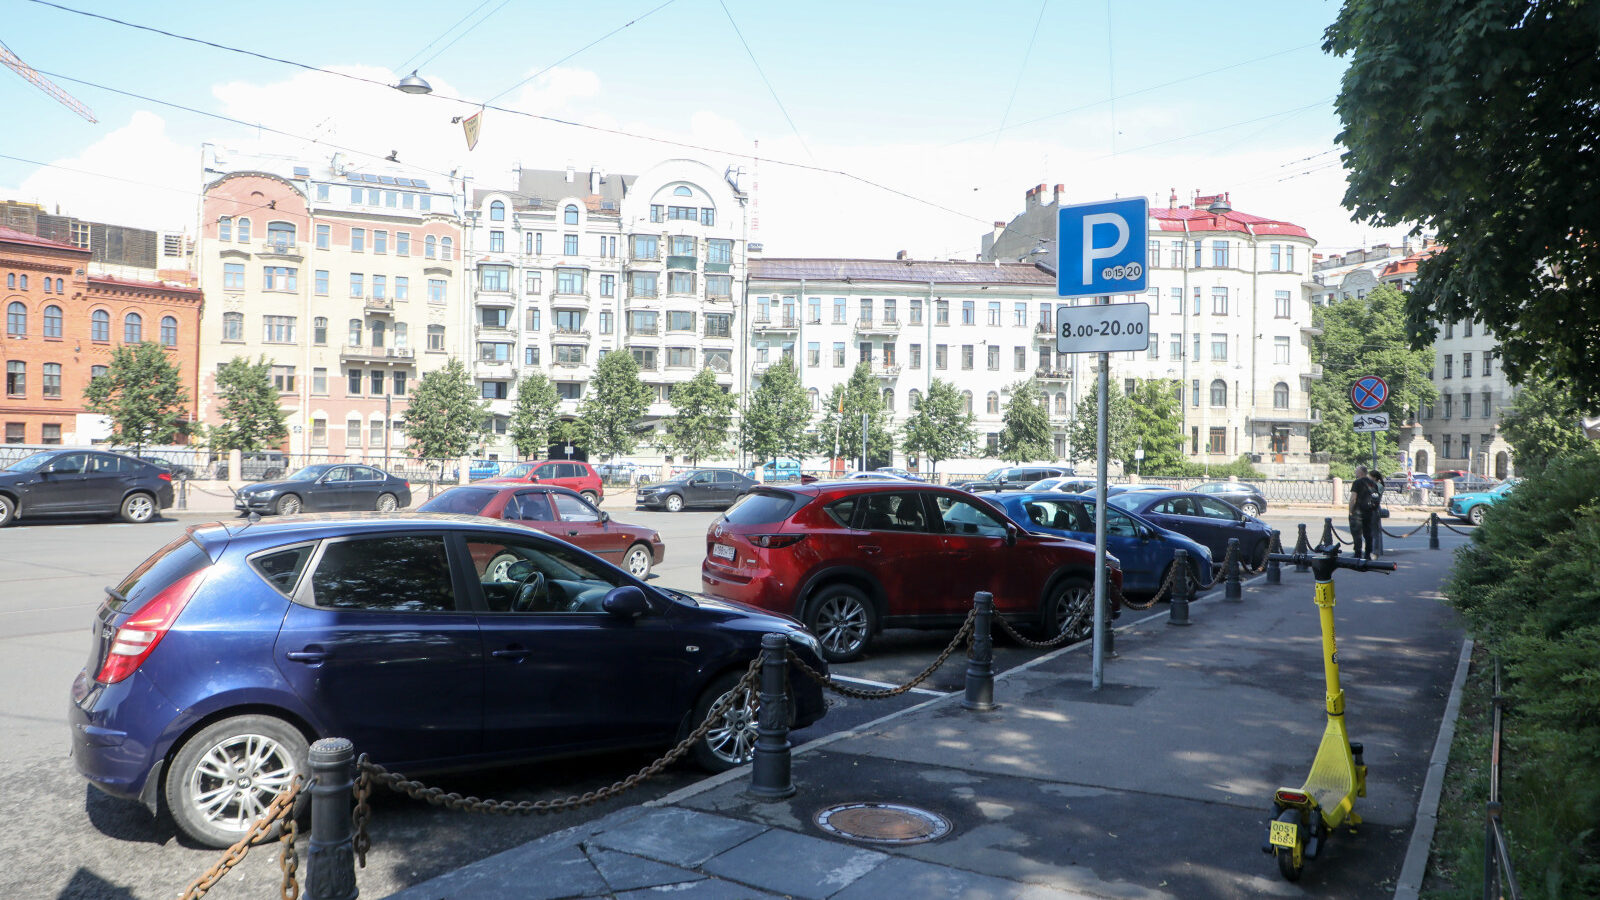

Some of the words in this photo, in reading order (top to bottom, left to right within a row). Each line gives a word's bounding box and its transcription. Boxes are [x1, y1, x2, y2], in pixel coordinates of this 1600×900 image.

[1083, 213, 1130, 286] P
[1105, 269, 1112, 277] 10
[1114, 265, 1124, 277] 15
[1126, 265, 1141, 277] 20
[1062, 320, 1143, 338] 8.00-20.00
[1272, 824, 1295, 834] 0051
